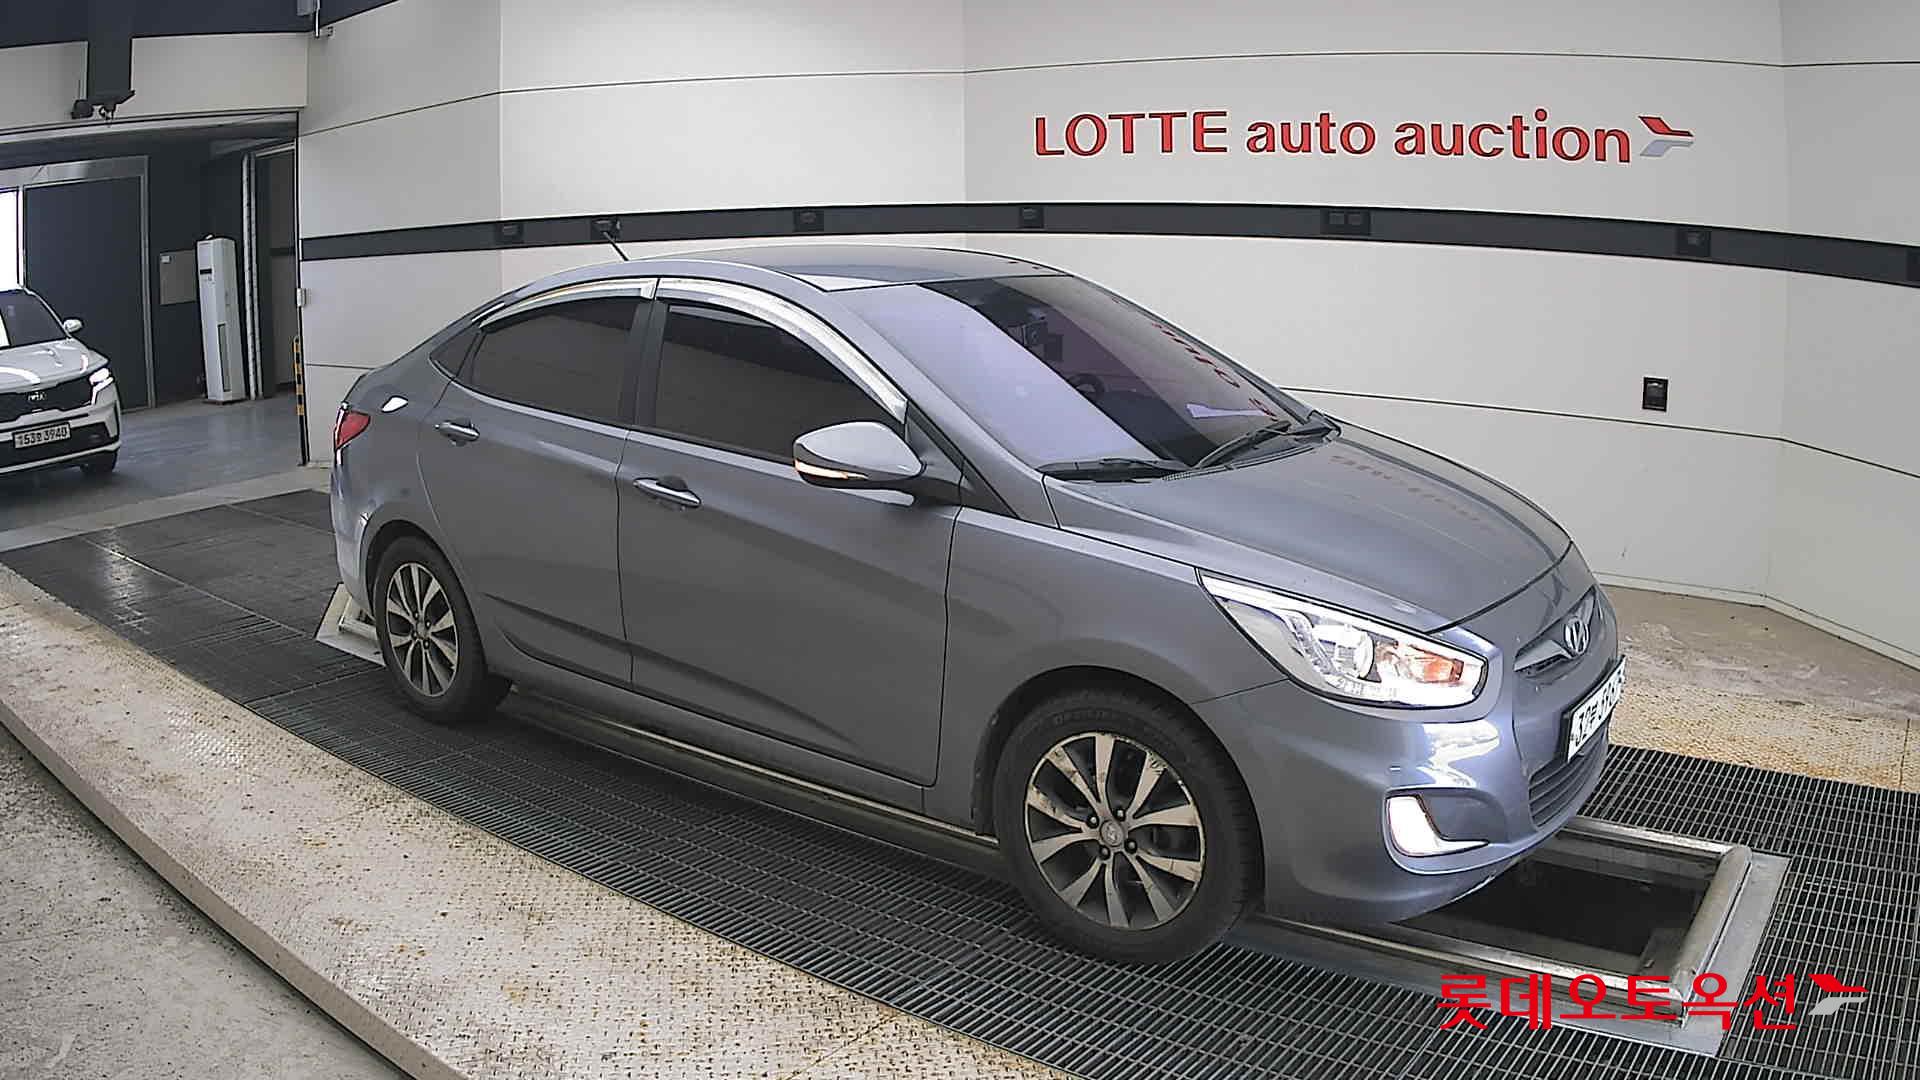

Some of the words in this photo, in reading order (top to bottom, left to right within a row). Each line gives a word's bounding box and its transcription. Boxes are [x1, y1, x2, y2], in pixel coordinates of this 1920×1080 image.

[1035, 110, 1228, 155] LOTTE
[1245, 113, 1377, 154] auto
[1395, 110, 1631, 162] auction
